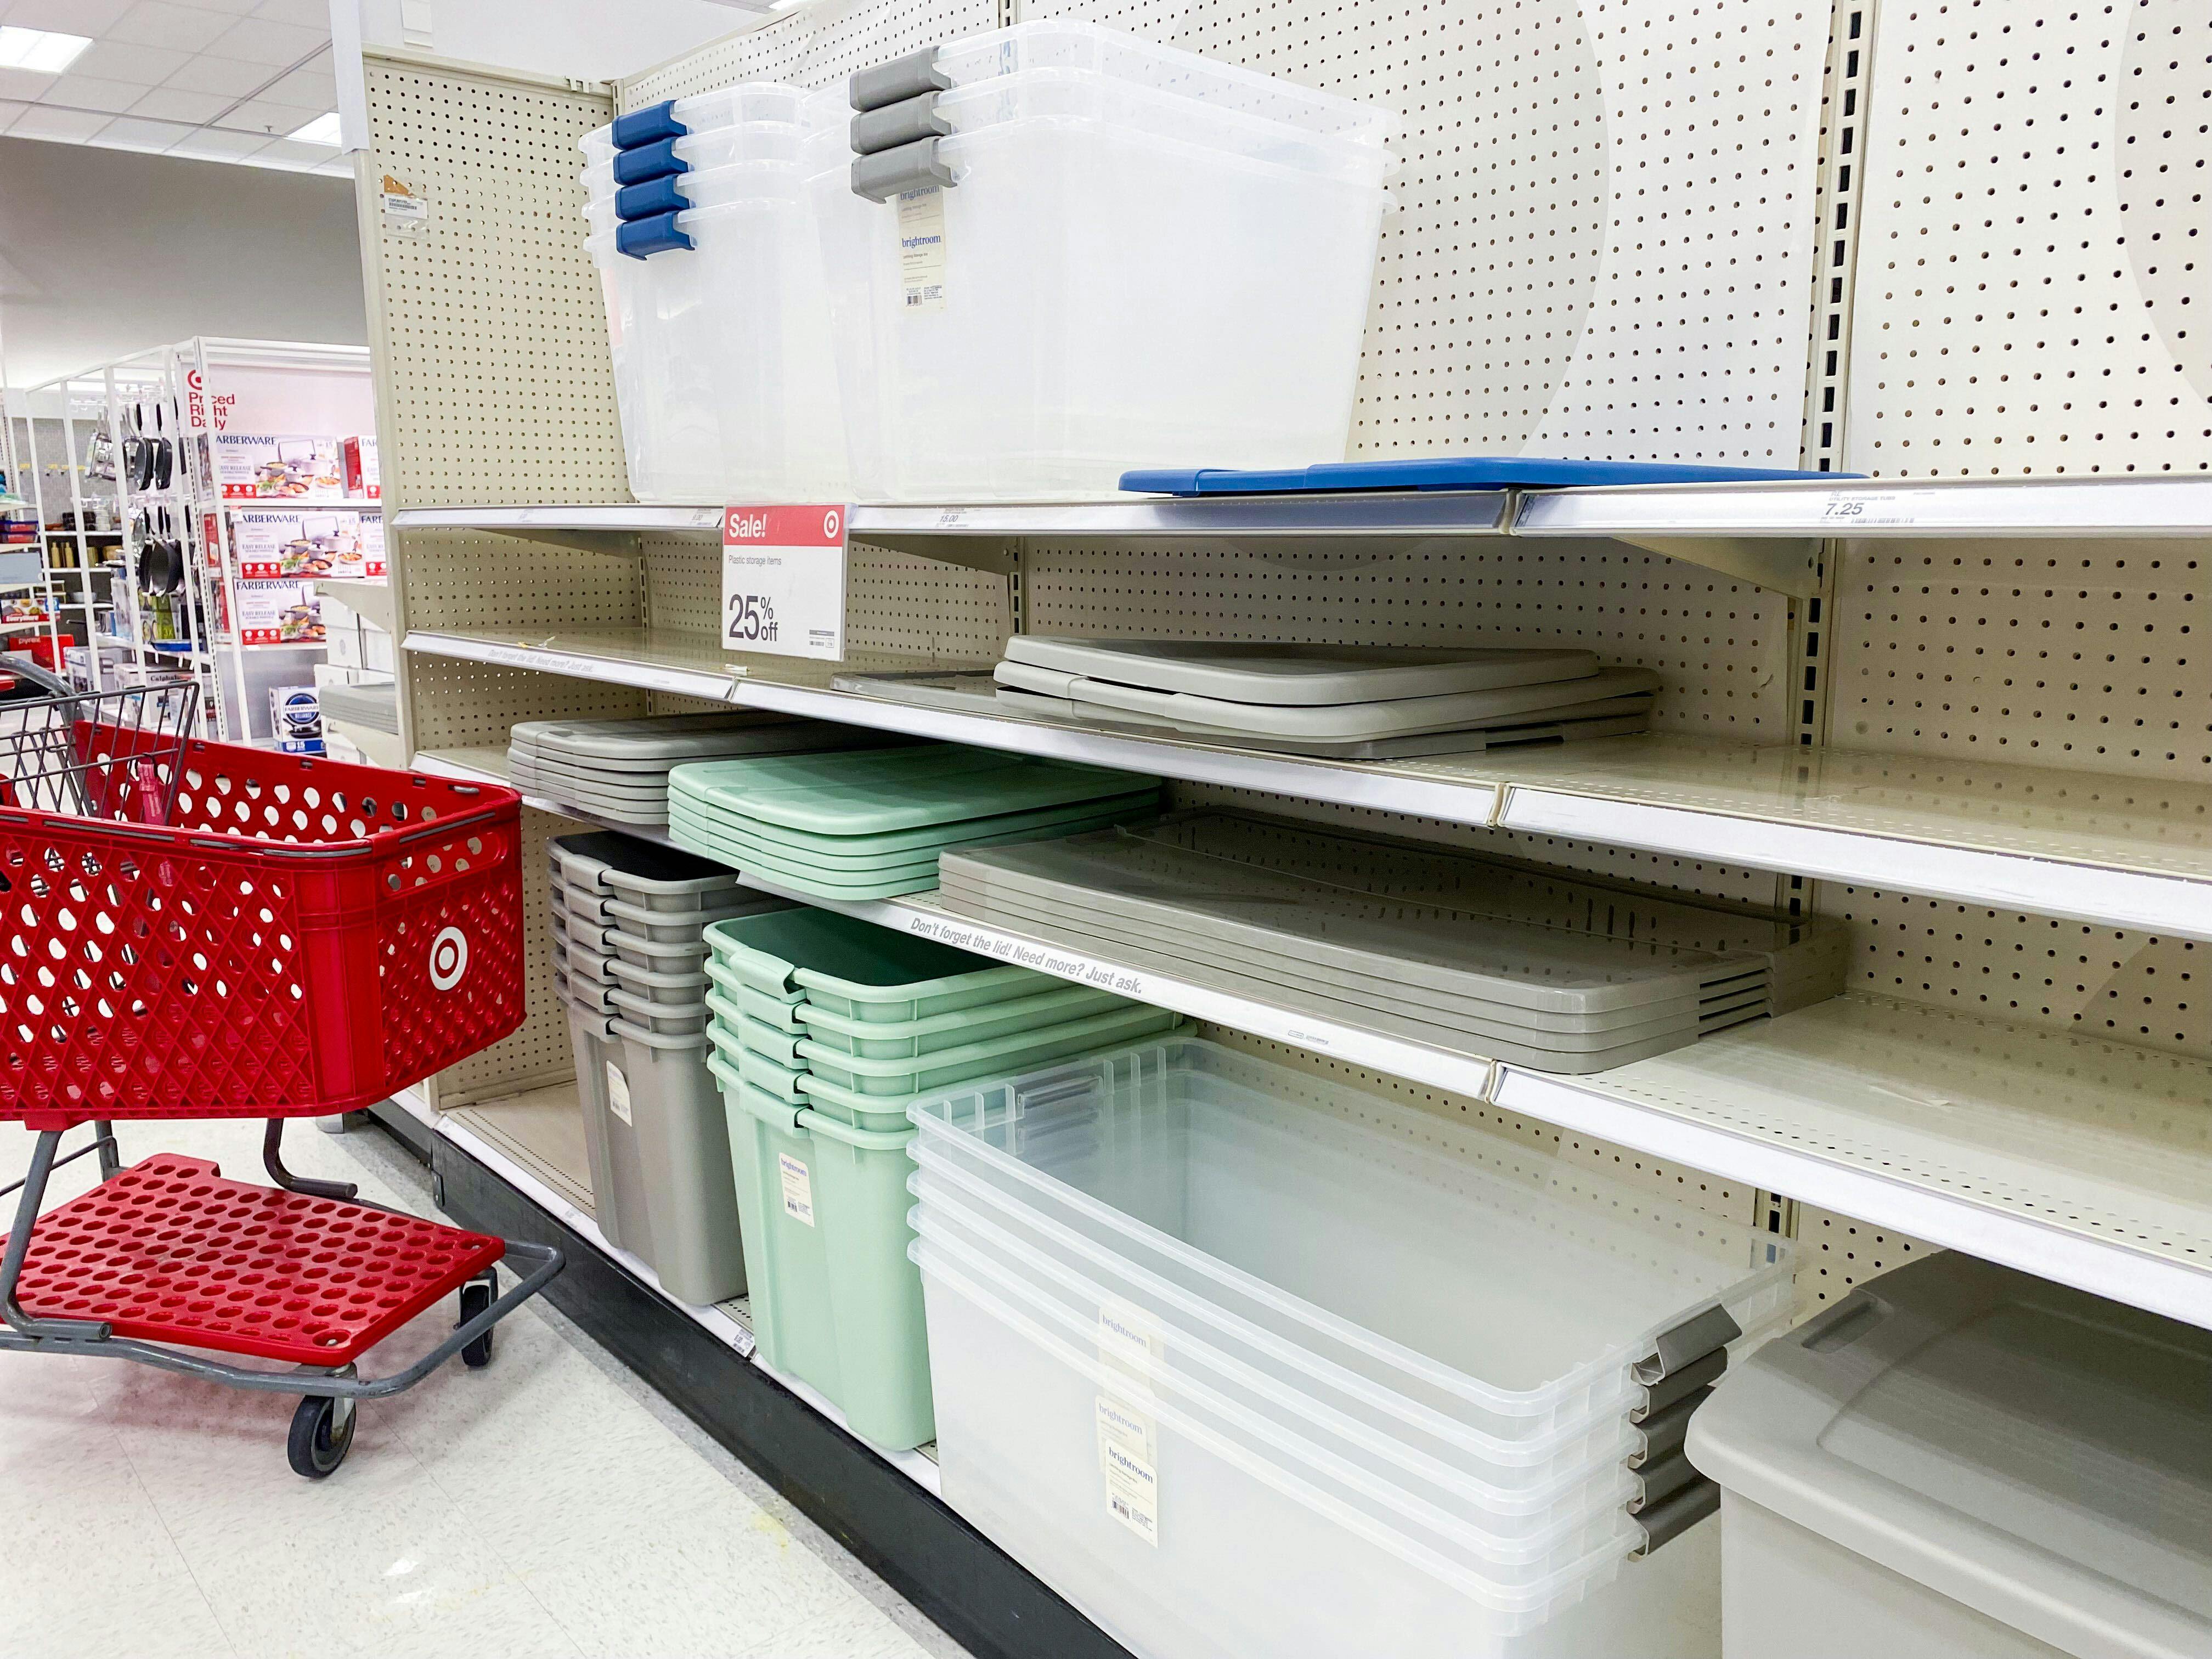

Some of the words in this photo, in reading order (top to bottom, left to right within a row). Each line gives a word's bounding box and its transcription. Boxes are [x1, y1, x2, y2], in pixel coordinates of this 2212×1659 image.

[900, 185, 939, 201] brightroom
[901, 235, 941, 249] brightroom
[189, 392, 235, 405] Prced
[190, 404, 228, 416] Riht
[191, 416, 226, 431] Daly
[216, 435, 277, 445] ARBERWARE
[1825, 503, 1865, 515] 7.25
[242, 514, 300, 523] ARBERWARE
[729, 513, 767, 538] Sale!
[729, 555, 745, 565] Plastic
[746, 556, 766, 567] storage
[766, 556, 782, 566] items
[236, 580, 300, 590] FARBERWARE
[760, 622, 778, 642] off
[910, 917, 940, 935] Don't
[939, 925, 972, 945] forget
[973, 935, 991, 950] the
[993, 939, 1012, 956] lid!
[1013, 945, 1046, 966] Need
[1045, 957, 1086, 977] more?
[1086, 966, 1115, 986] Just
[1116, 977, 1142, 994] ask.
[781, 1158, 807, 1177] brightroom
[1102, 1314, 1147, 1348] brightroom
[1099, 1402, 1143, 1435] brightroom
[1108, 1446, 1154, 1484] brightroom
